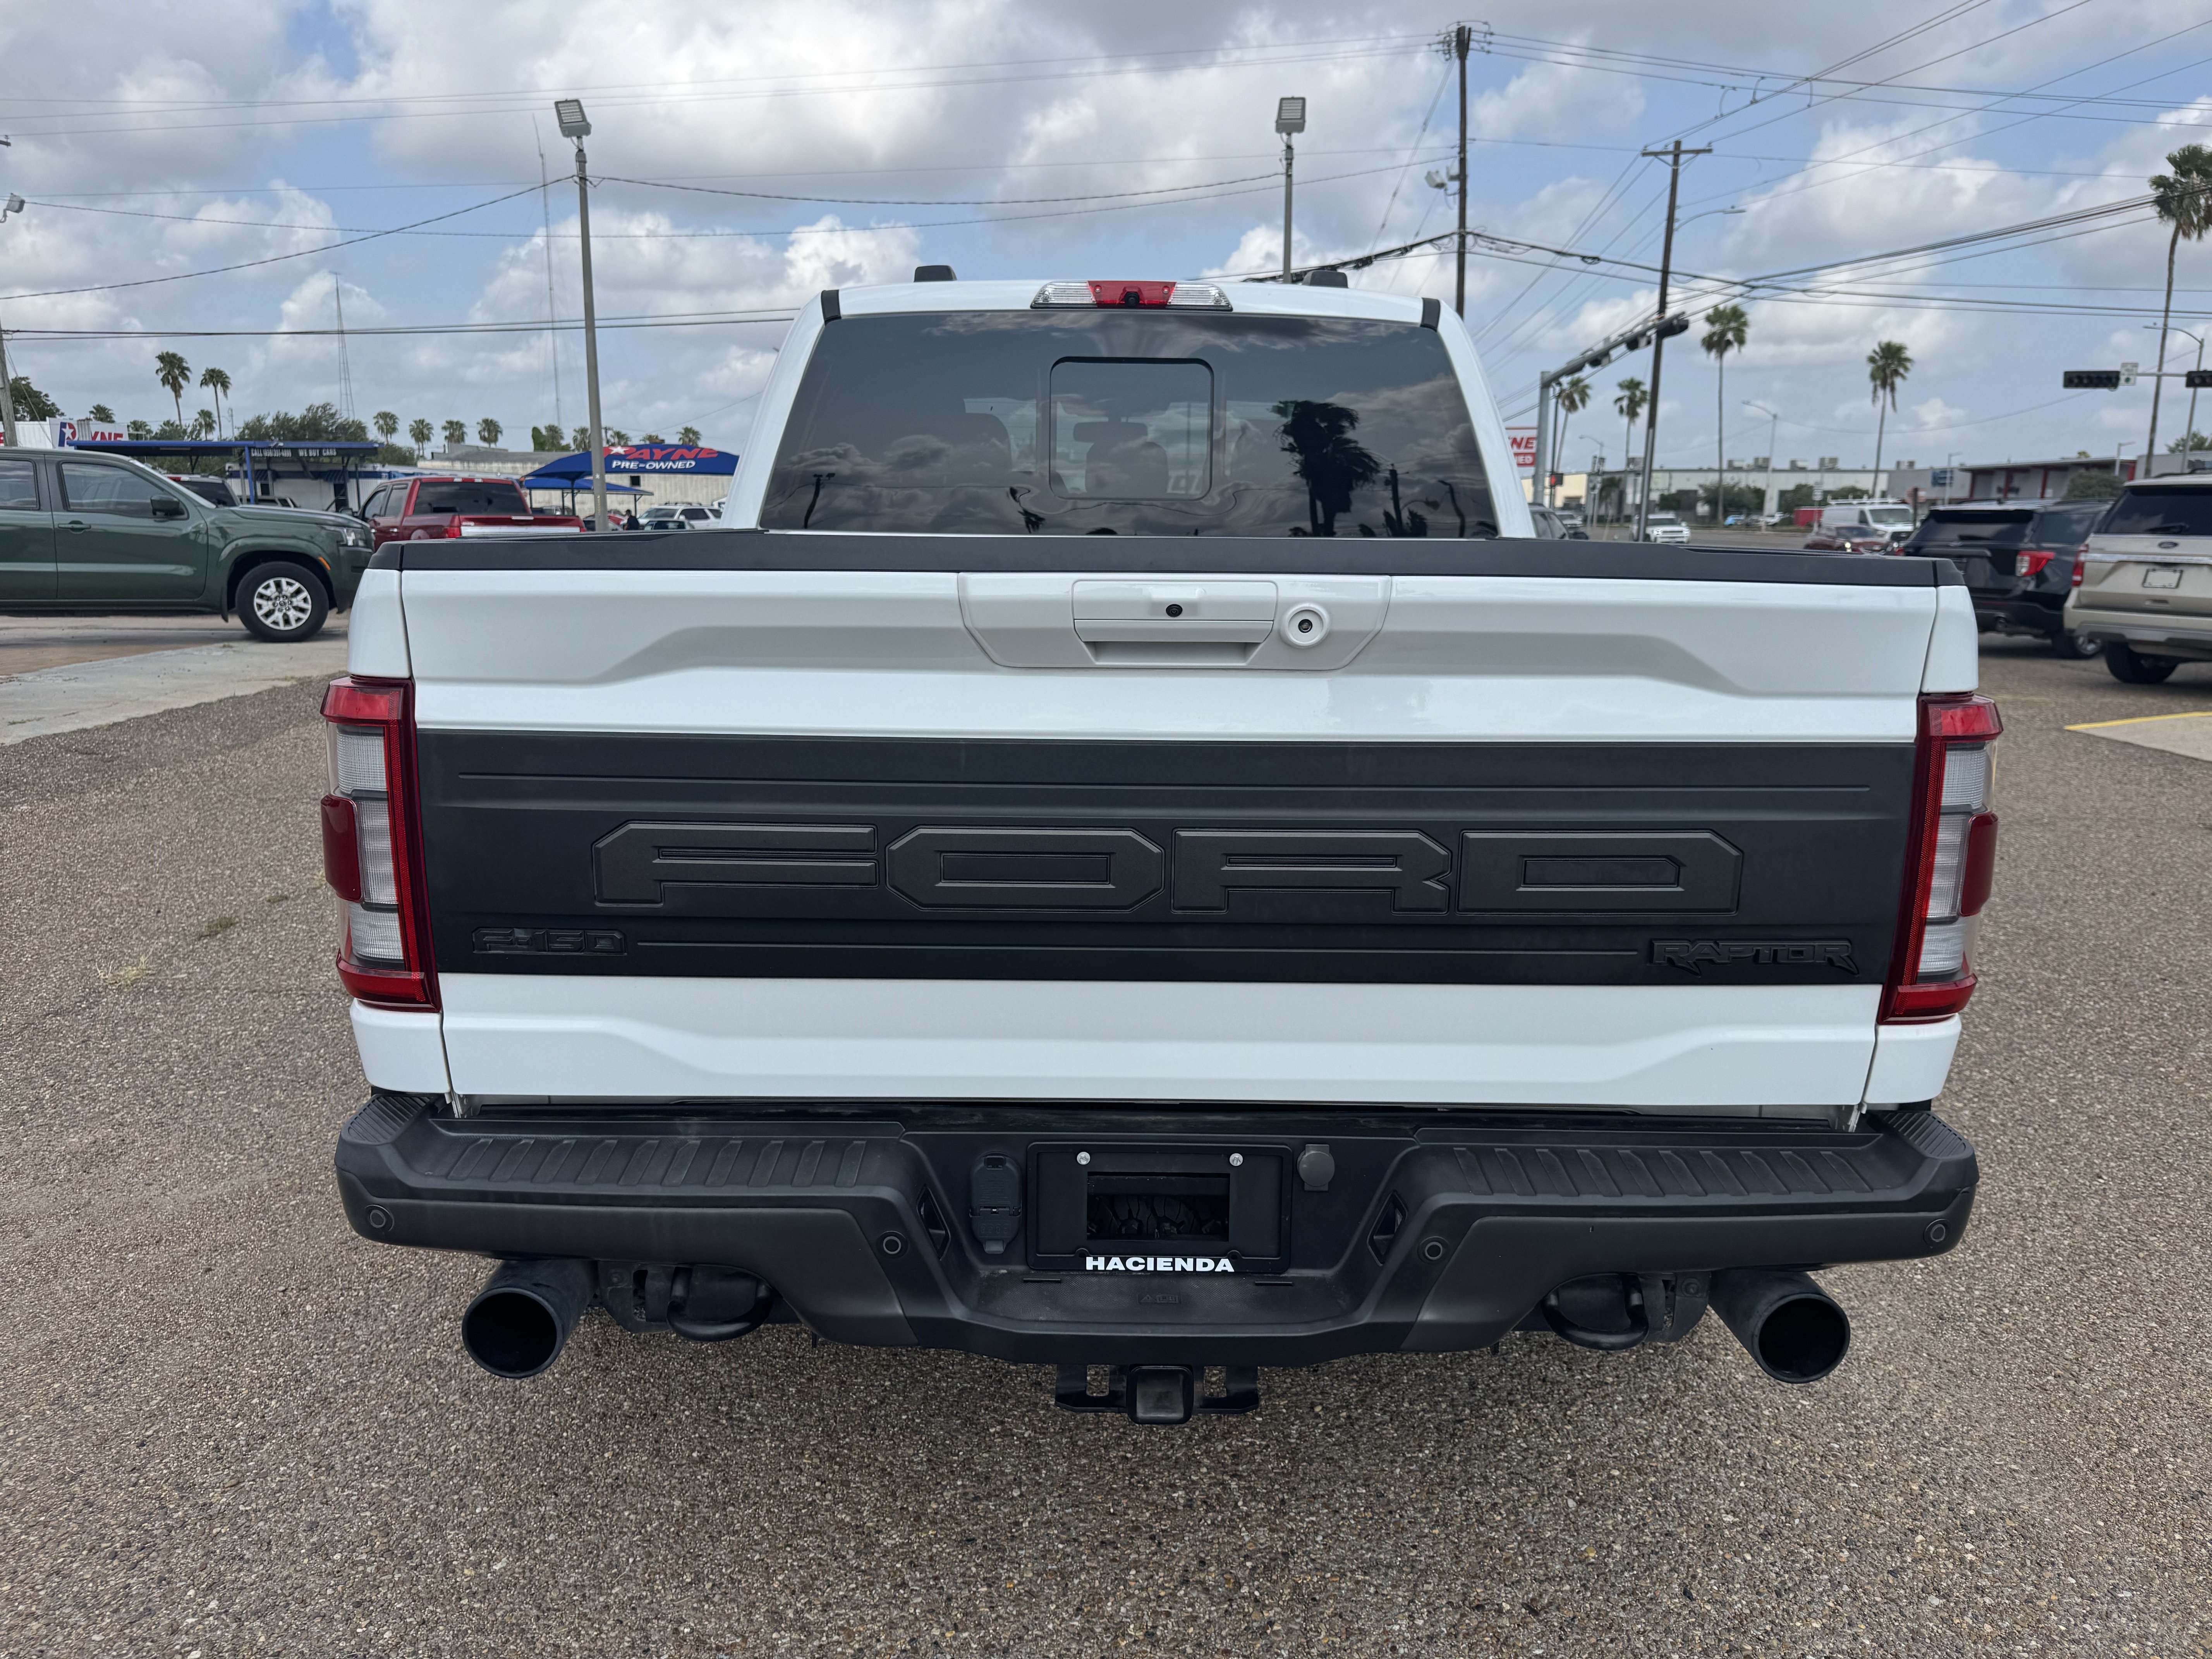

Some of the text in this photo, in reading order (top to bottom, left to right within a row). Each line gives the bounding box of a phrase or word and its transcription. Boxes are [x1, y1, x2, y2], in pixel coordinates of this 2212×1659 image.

[251, 448, 263, 457] CALL
[298, 448, 307, 457] WE
[309, 448, 319, 456] BUY
[322, 448, 337, 456] CARS
[603, 446, 718, 460] PAYNE
[612, 459, 696, 470] PRE-OWNED
[592, 821, 1744, 915] FORD
[1650, 939, 1859, 977] RAPTOR
[1085, 1256, 1235, 1272] HACIENDA
